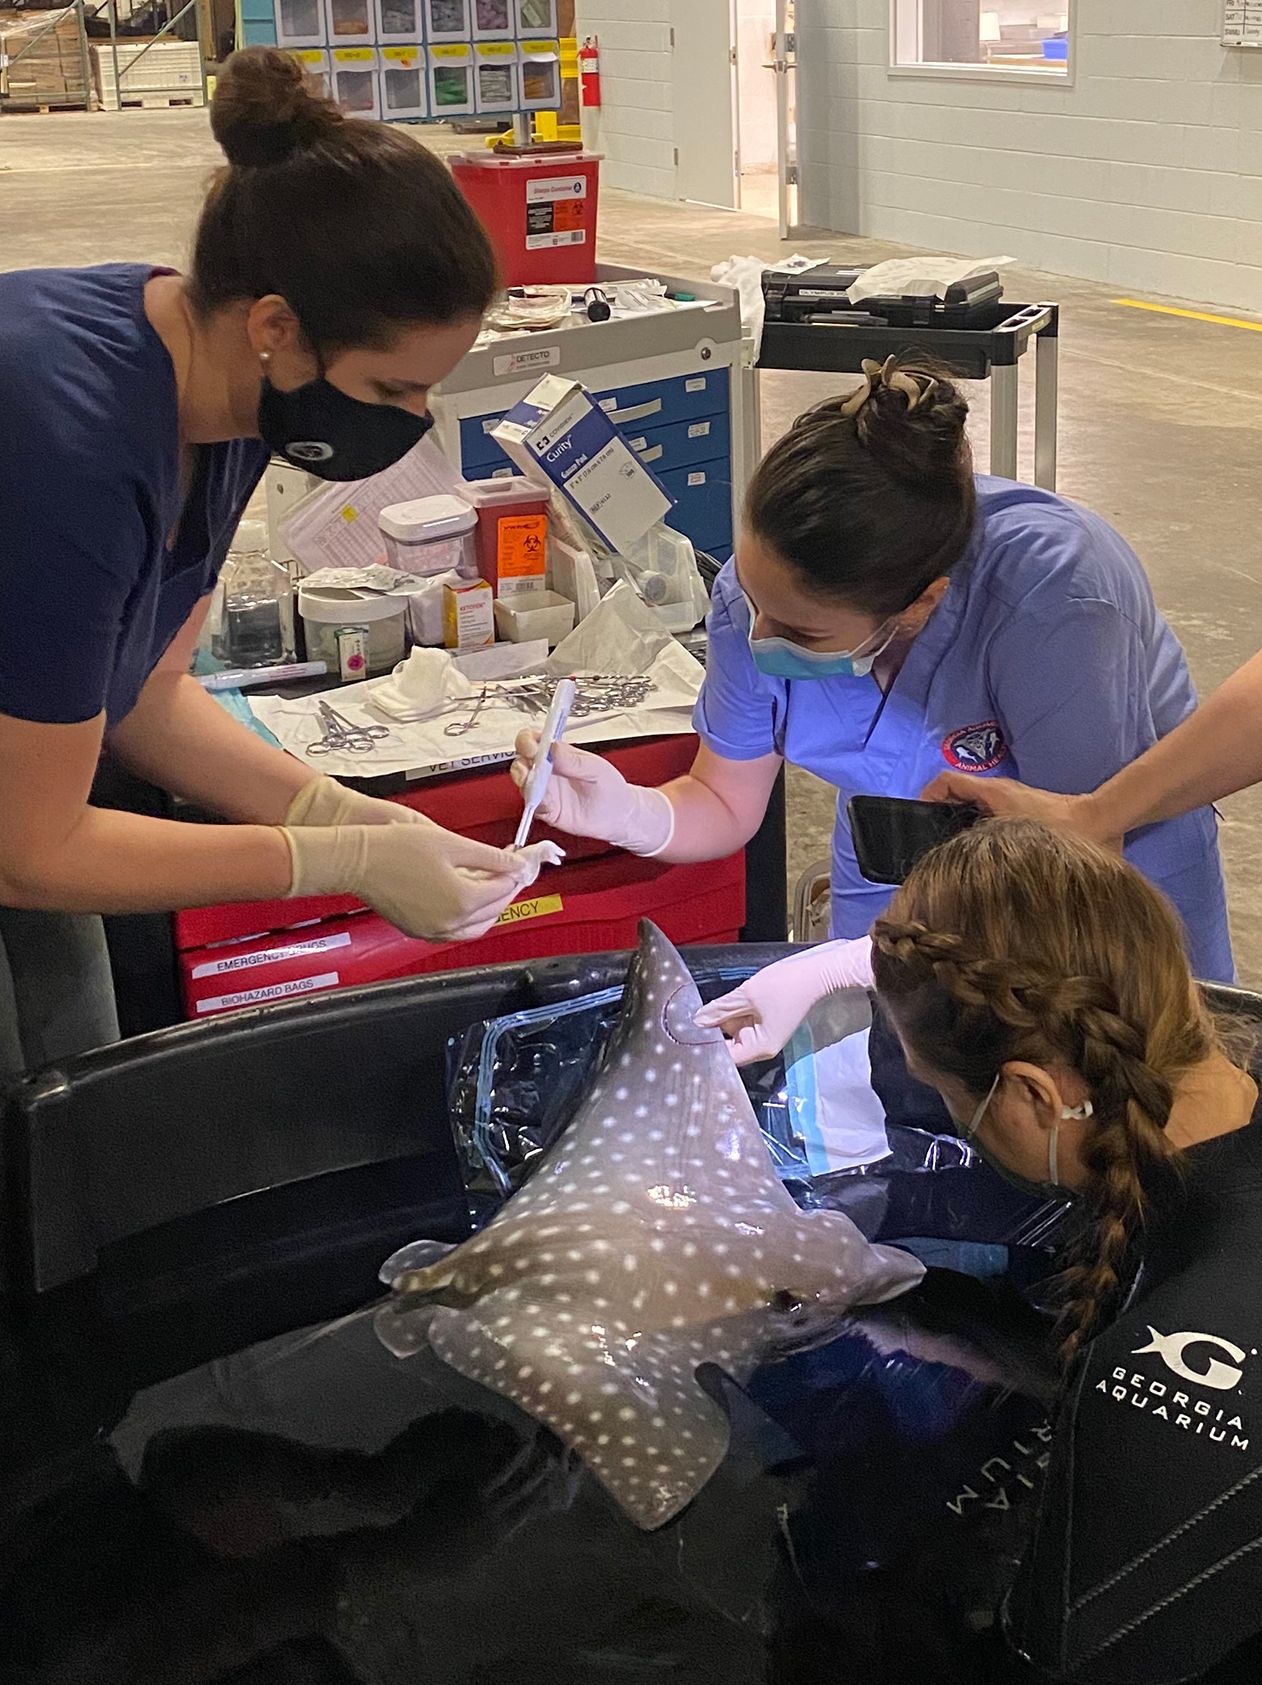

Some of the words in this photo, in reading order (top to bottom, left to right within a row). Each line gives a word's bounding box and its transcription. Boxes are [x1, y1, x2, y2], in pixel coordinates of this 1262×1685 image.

[516, 350, 551, 363] DETECTO
[461, 751, 518, 766] SERVIC
[495, 900, 540, 923] ENCY
[221, 985, 283, 1007] BIOHAZARD
[284, 979, 314, 993] BAGS
[1112, 1366, 1243, 1431] GEORGIA
[1095, 1379, 1250, 1451] AQUARIUM
